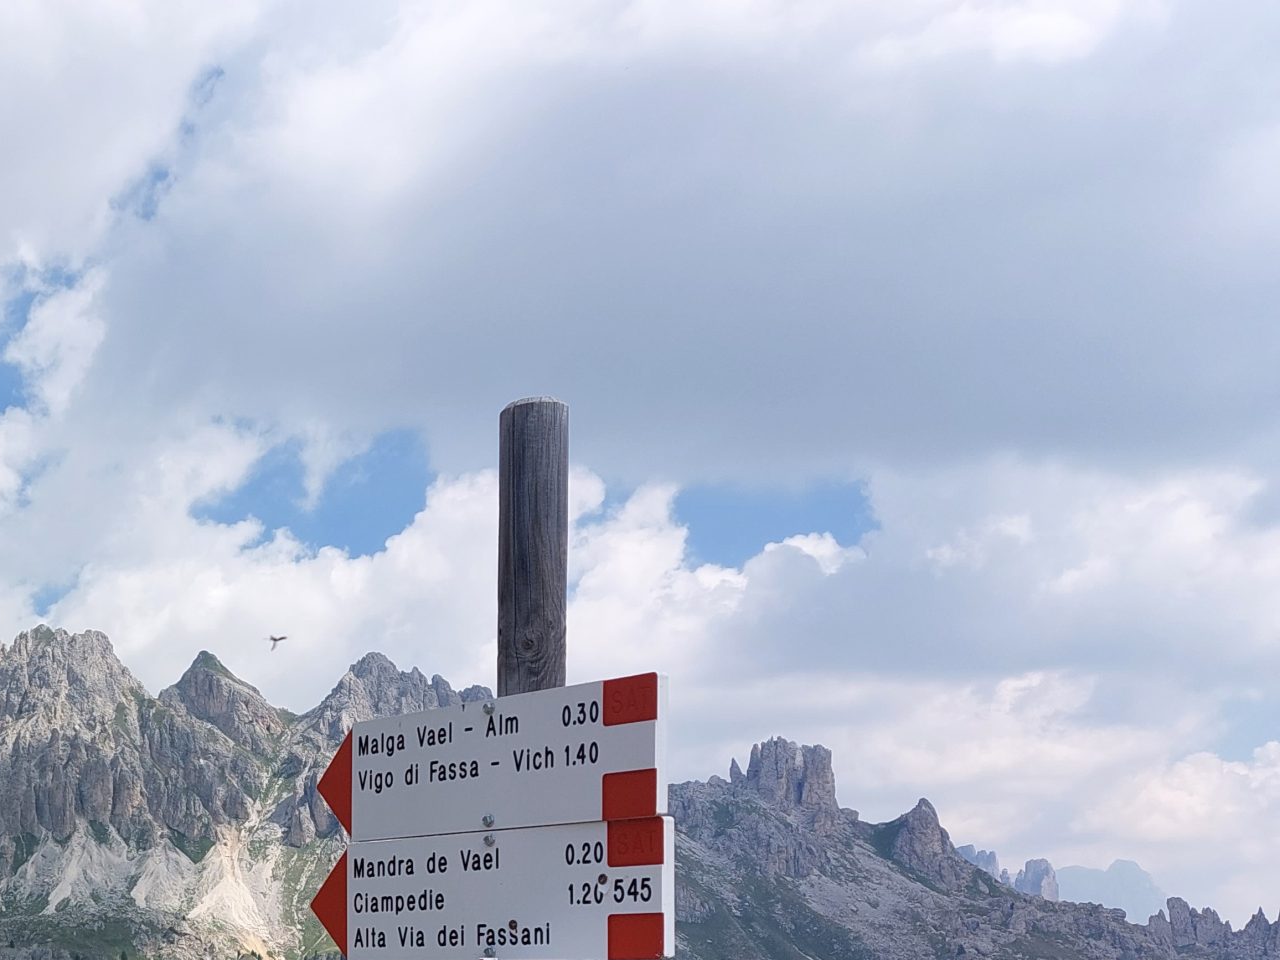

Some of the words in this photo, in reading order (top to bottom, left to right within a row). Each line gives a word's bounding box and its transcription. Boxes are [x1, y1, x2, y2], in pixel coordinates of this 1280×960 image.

[358, 732, 405, 758] Malga
[416, 721, 453, 748] Vael
[485, 714, 519, 737] Alm
[561, 700, 600, 727] 0.30
[358, 769, 394, 794] Vigo
[404, 763, 419, 785] di
[429, 760, 480, 783] Fassa
[512, 746, 555, 772] Vich
[564, 741, 599, 767] 1.40
[353, 854, 415, 879] Mandra
[426, 851, 448, 874] de
[459, 847, 500, 872] Vael
[565, 840, 604, 866] 0.20
[353, 890, 445, 916] Ciampedie
[567, 882, 604, 906] 1.20
[613, 877, 652, 904] 545
[353, 926, 387, 949] Alta
[397, 926, 426, 948] Via
[437, 924, 465, 947] dei
[476, 922, 551, 947] Fassani
